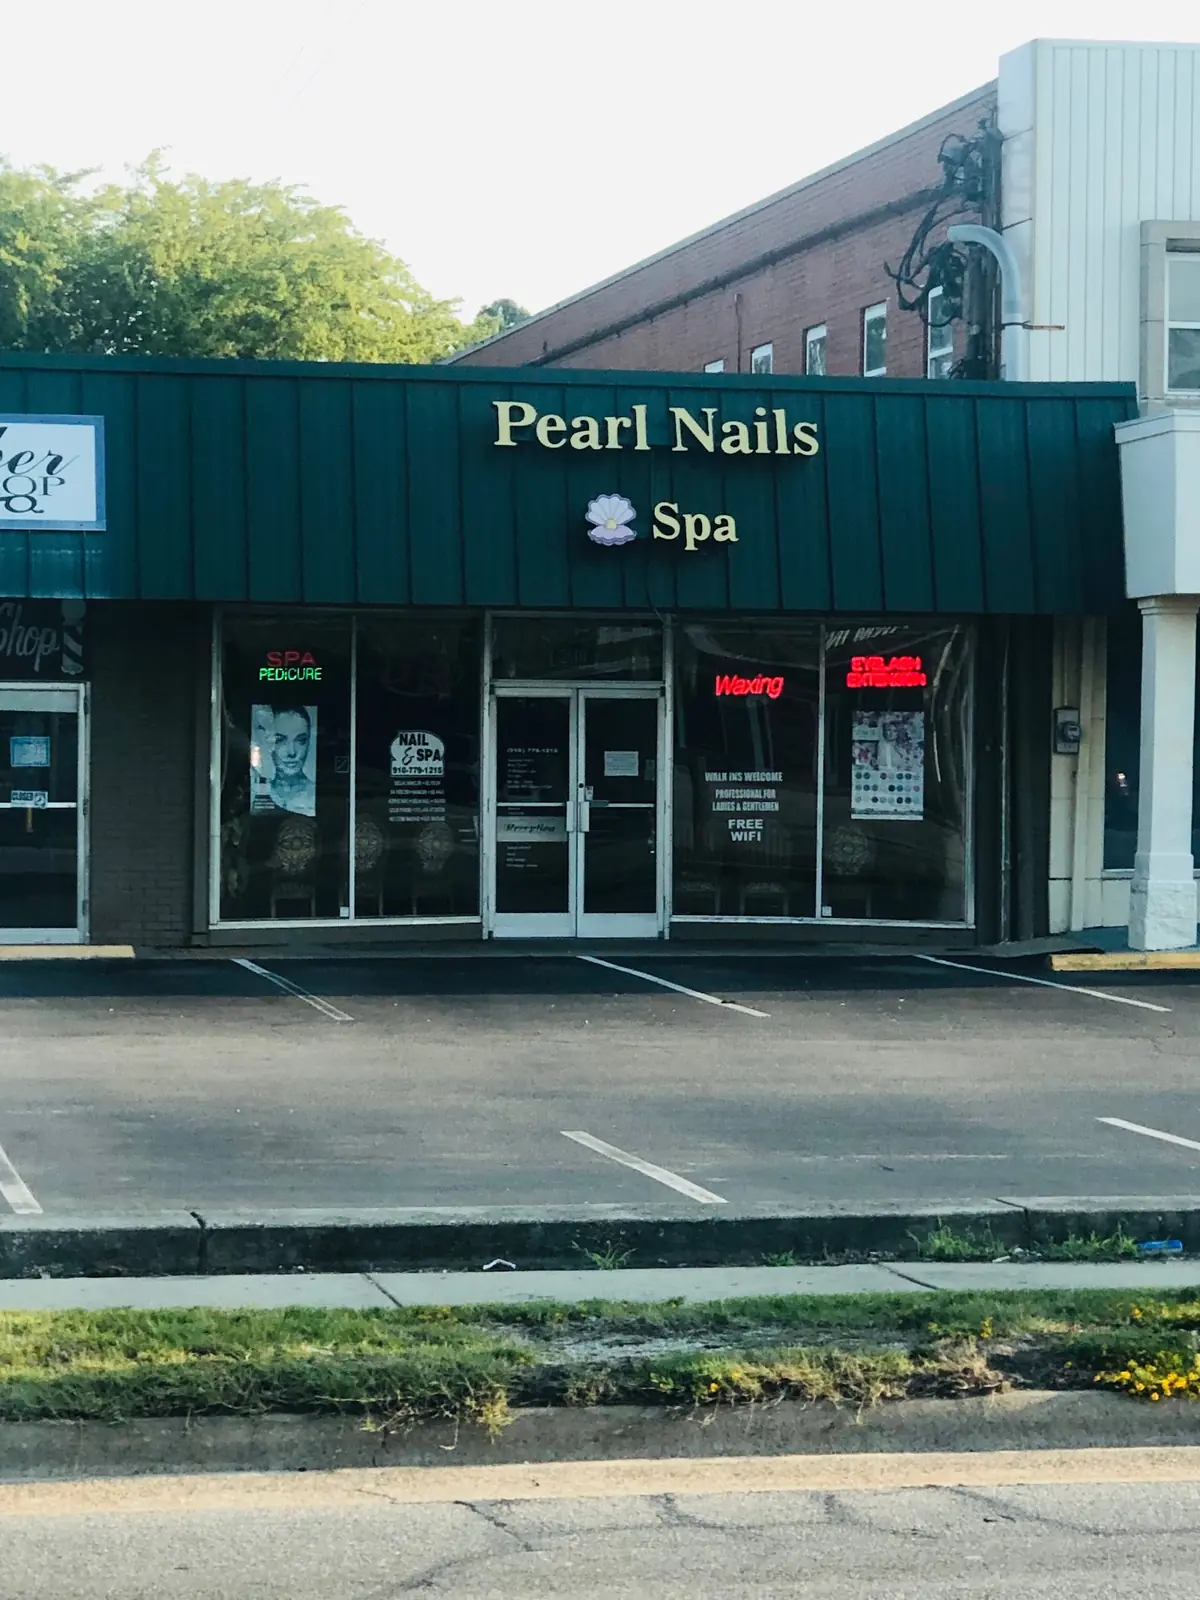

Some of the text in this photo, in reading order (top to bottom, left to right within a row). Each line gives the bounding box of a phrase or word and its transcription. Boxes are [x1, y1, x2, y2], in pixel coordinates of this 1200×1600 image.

[493, 401, 820, 456] Pearl Nails
[652, 501, 739, 551] Spa
[267, 651, 317, 667] SPA
[715, 673, 785, 699] Waxing
[399, 733, 429, 746] NAIL
[402, 747, 441, 765] & SPA
[704, 772, 728, 782] WALK
[744, 772, 784, 782] WELCOME
[715, 788, 763, 799] PROFESSIONAL
[712, 802, 736, 812] LADIES
[742, 802, 780, 812] GENTLEMEN
[728, 819, 764, 829] FREE
[730, 831, 762, 841] WIFI
